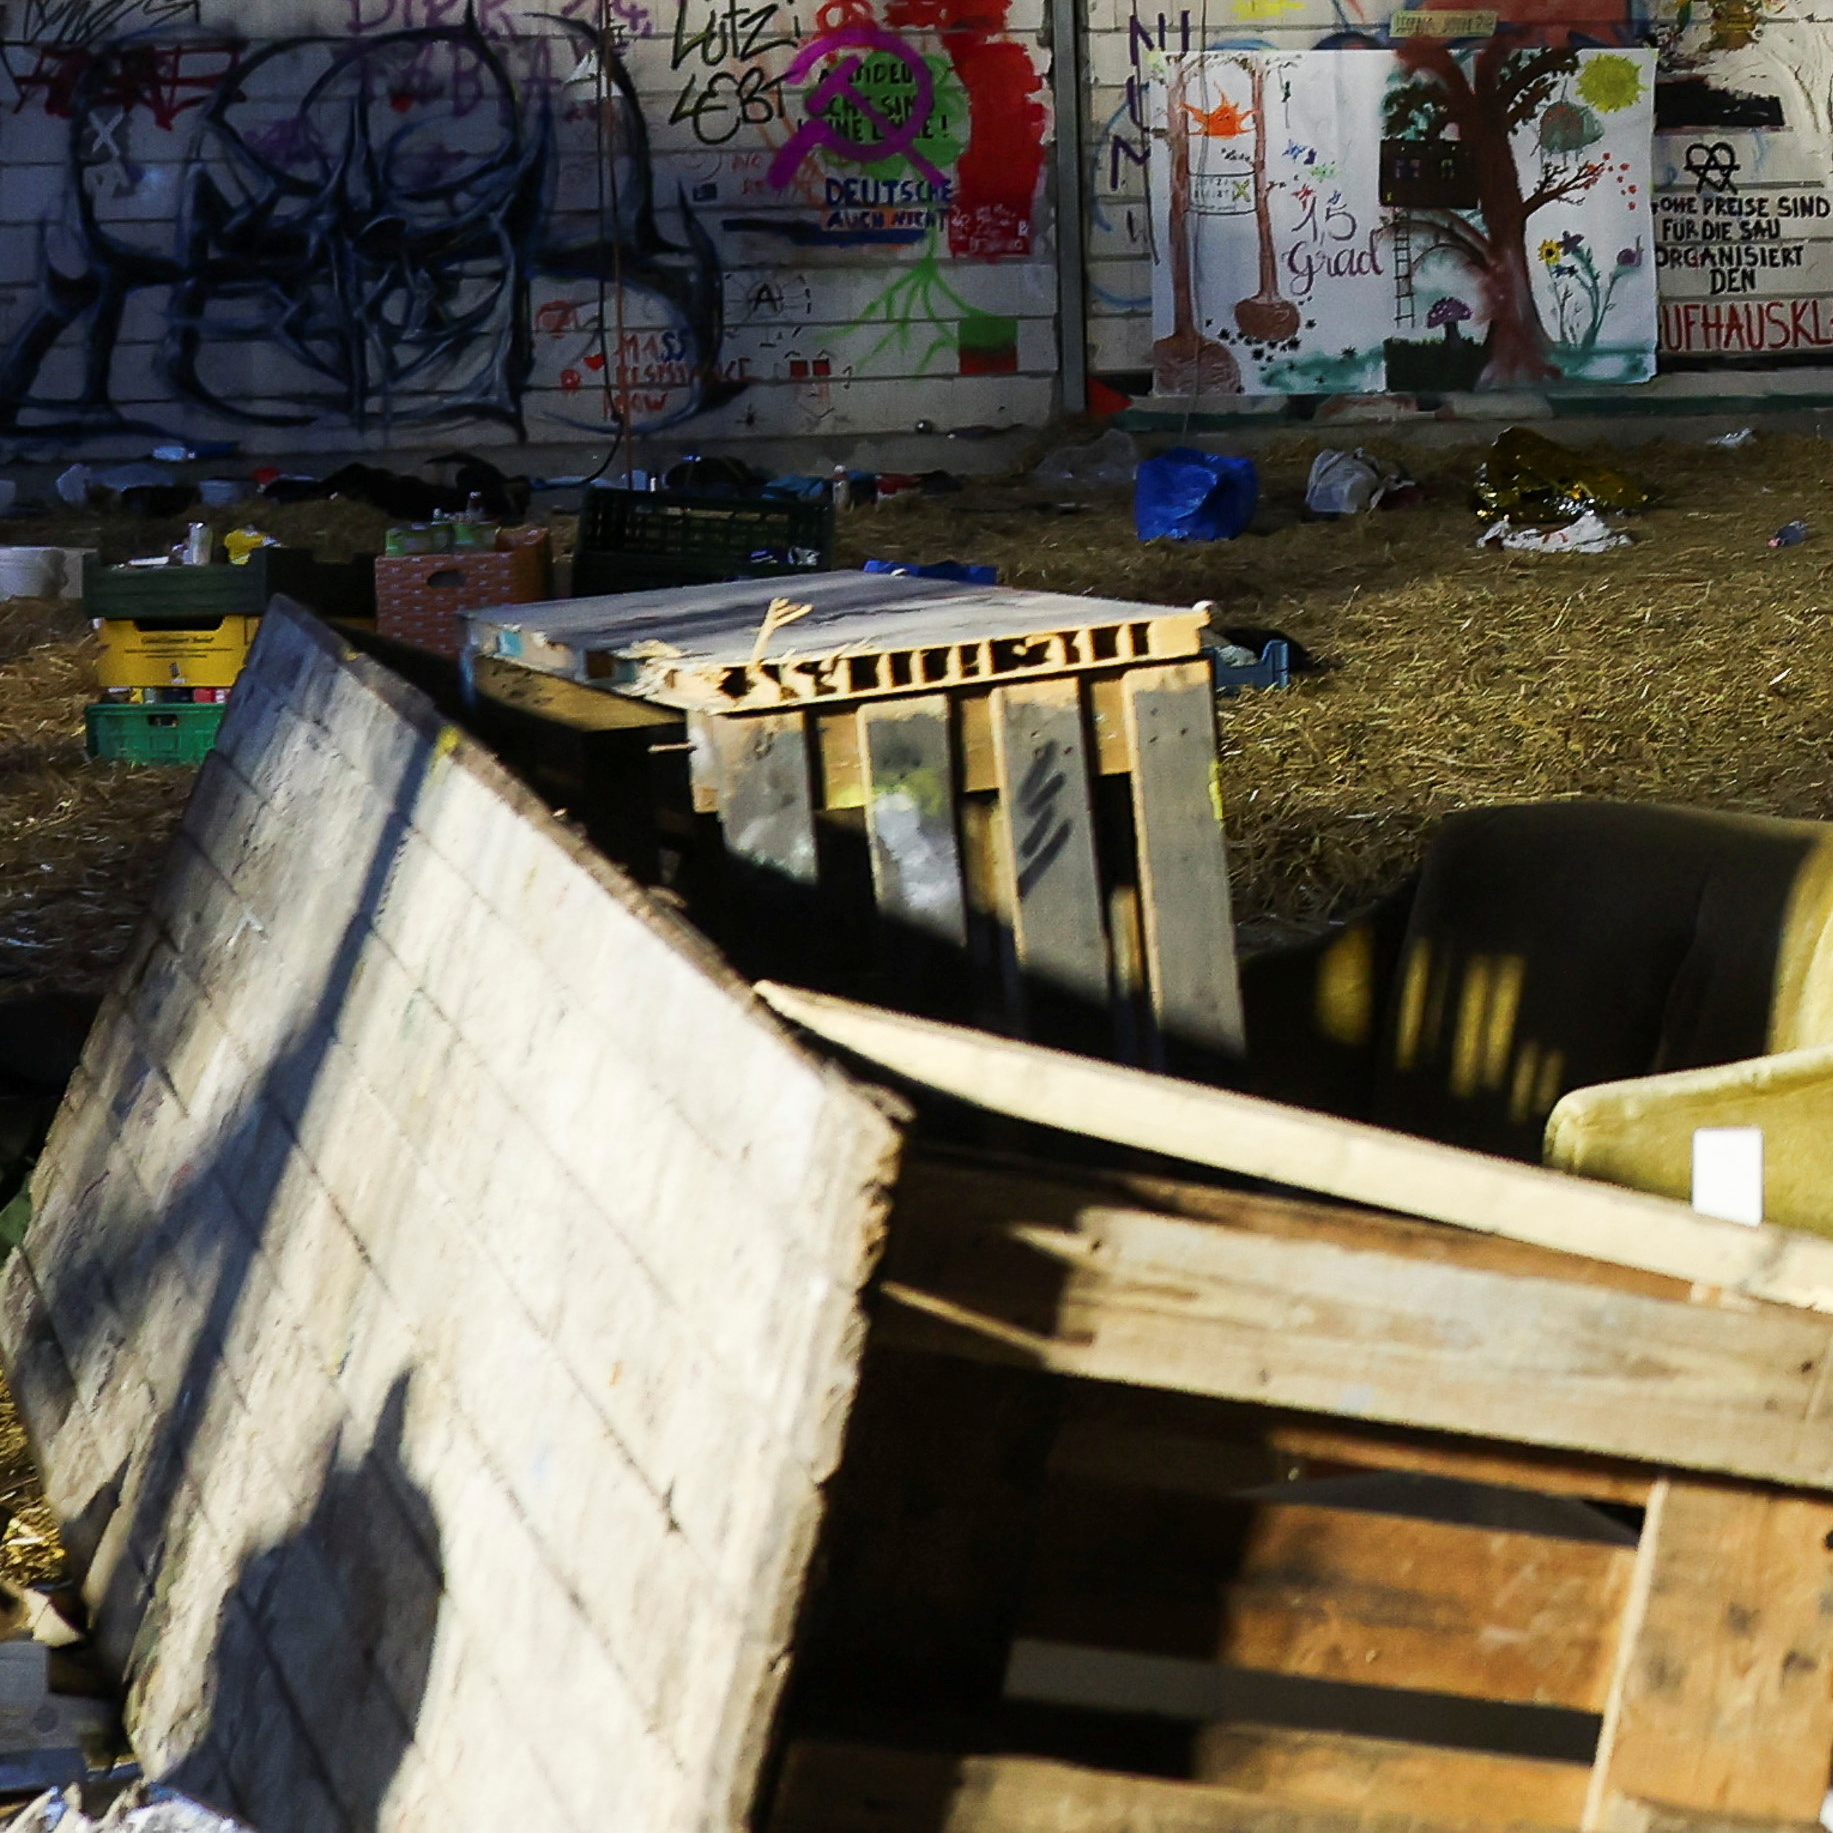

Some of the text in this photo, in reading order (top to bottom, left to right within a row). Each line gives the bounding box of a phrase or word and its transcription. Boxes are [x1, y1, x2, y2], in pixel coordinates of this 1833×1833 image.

[1703, 197, 1769, 217] PREISE
[1777, 196, 1831, 218] SIND
[1702, 219, 1733, 241] DIE
[1739, 218, 1781, 241] SAU
[1655, 245, 1804, 268] ORGANISIERT
[1710, 268, 1756, 295] DEN
